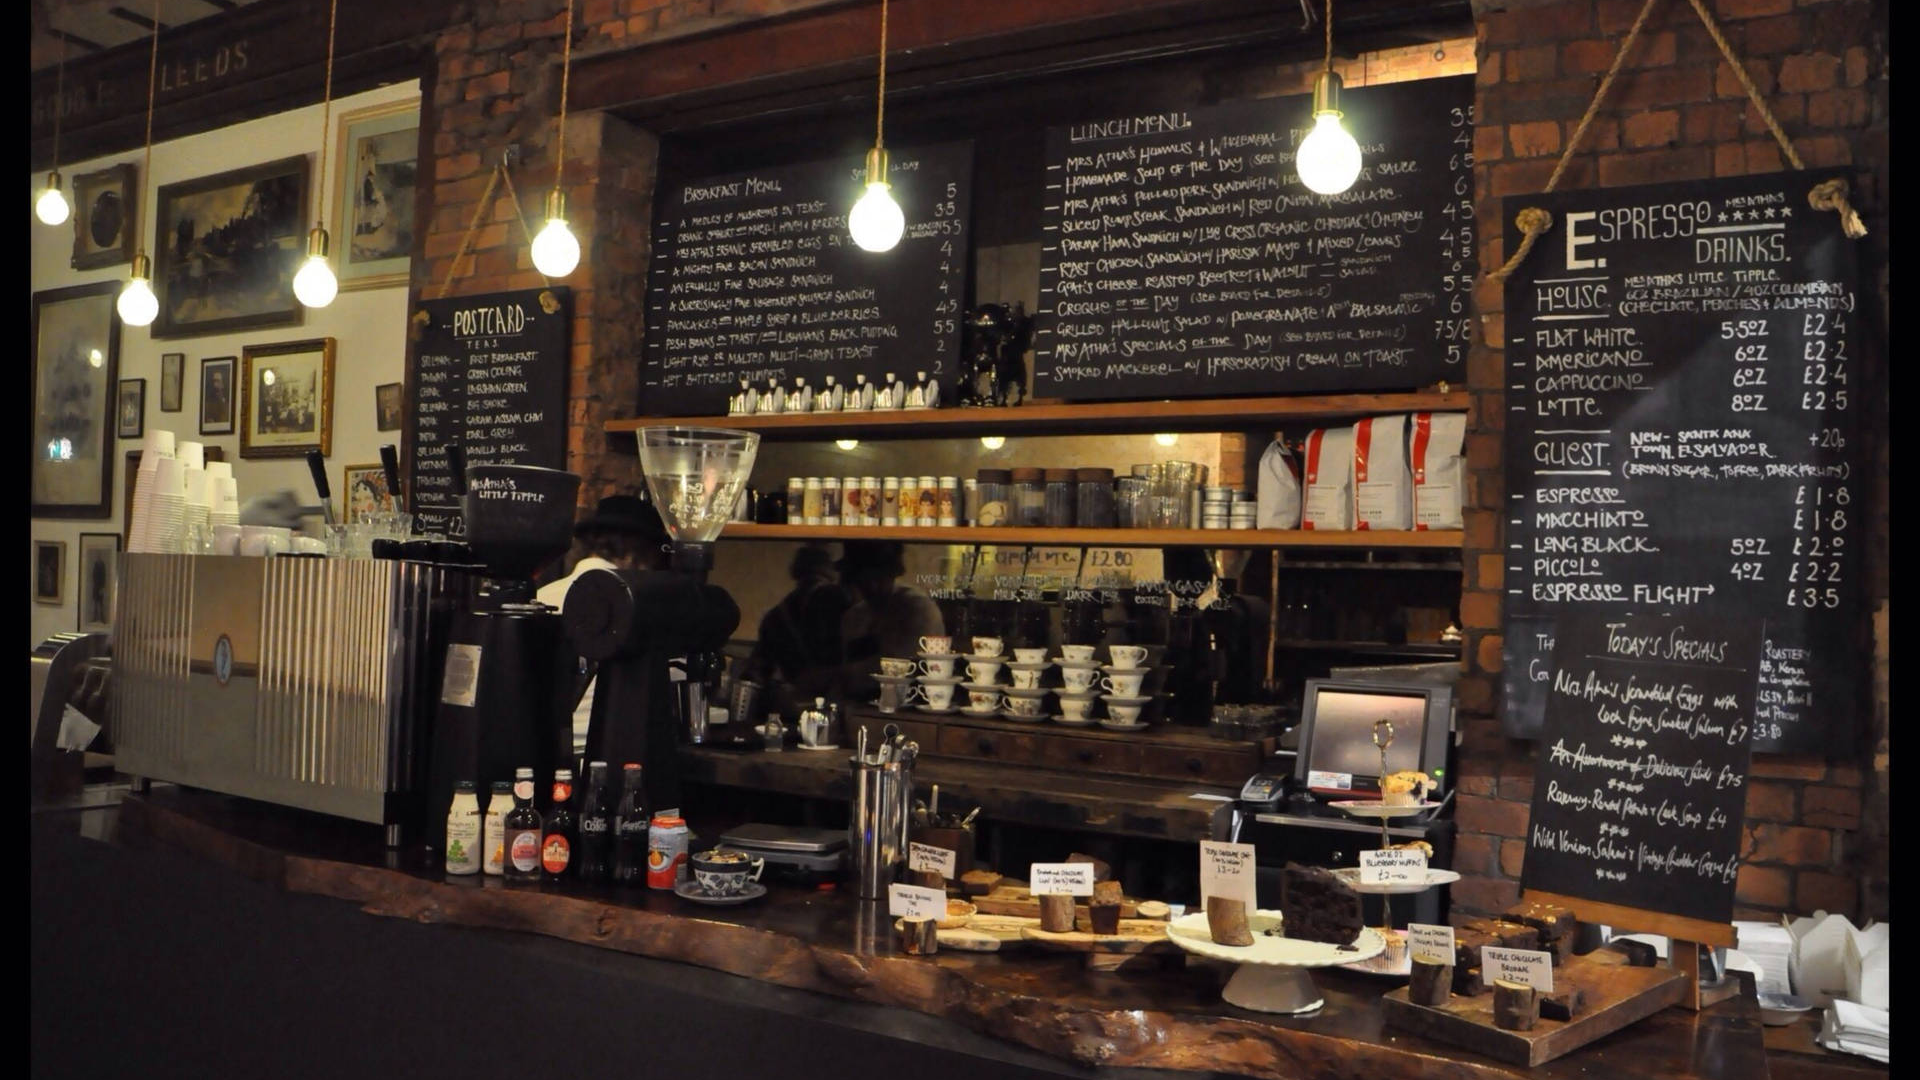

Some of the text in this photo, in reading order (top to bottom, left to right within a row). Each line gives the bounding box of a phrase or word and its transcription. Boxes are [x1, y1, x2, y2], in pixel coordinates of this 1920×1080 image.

[1071, 118, 1130, 141] LUNCH
[1134, 166, 1165, 185] SOUP
[453, 303, 525, 337] POSTCARD
[1536, 327, 1578, 348] FLAT
[1536, 350, 1650, 371] AMERICANO
[1536, 373, 1650, 393] CAPPUCCINO
[1678, 428, 1752, 443] SANTA ANA
[1536, 487, 1625, 504] ESPRESSO
[1536, 509, 1649, 530] MACCHIATO
[1535, 536, 1578, 553] LONG
[1534, 557, 1603, 577] PICCOLO
[1533, 583, 1629, 602] ESPRESSO
[1634, 584, 1702, 605] FLIGHT
[1606, 623, 1728, 663] TODAY'S SPECIALS
